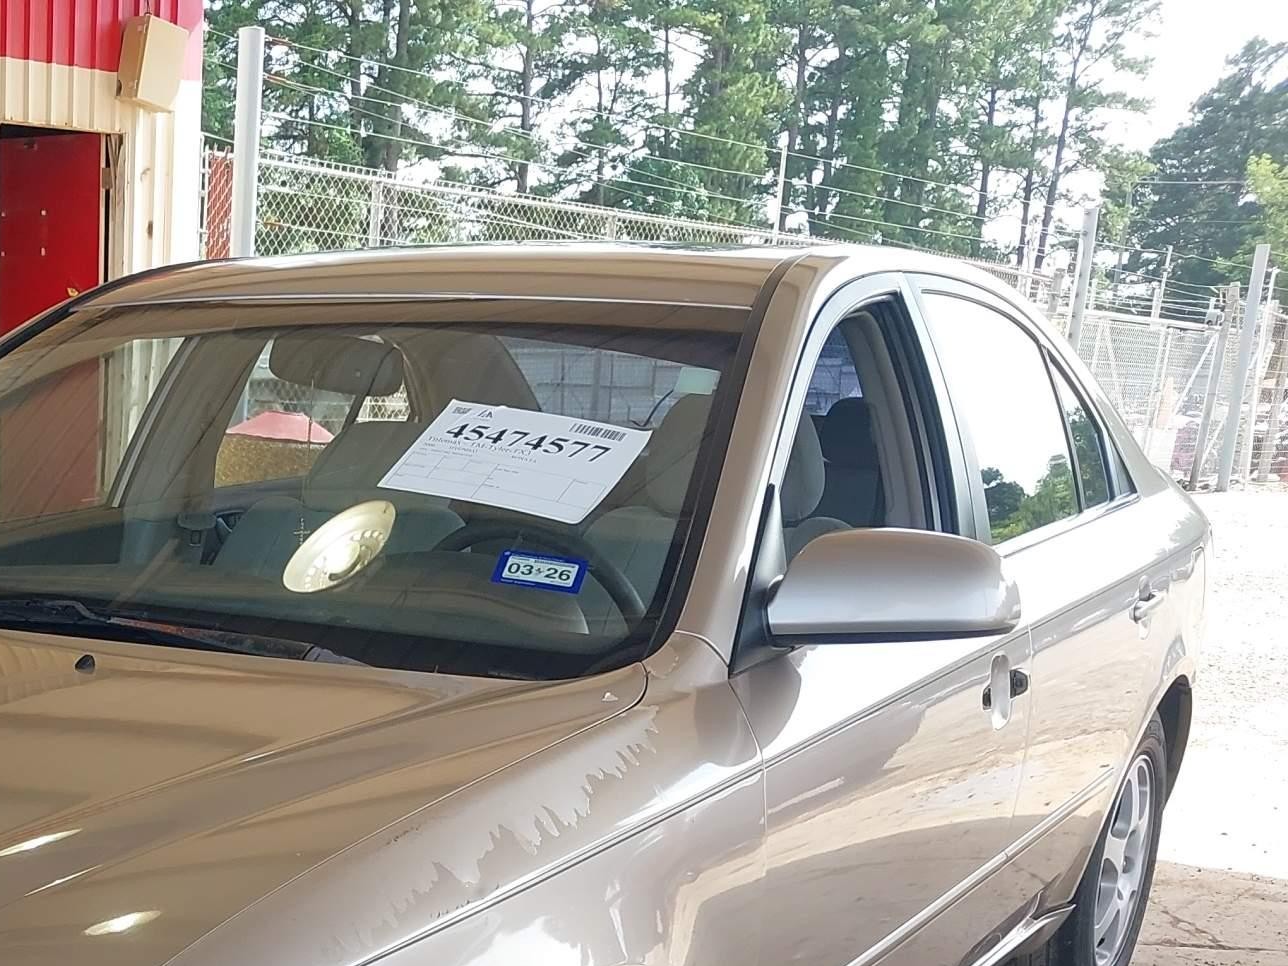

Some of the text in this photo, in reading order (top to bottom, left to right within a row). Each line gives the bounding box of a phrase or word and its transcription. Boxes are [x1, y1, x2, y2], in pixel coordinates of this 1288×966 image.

[445, 422, 612, 463] 45474577
[507, 562, 534, 576] 03
[544, 567, 573, 582] 26
